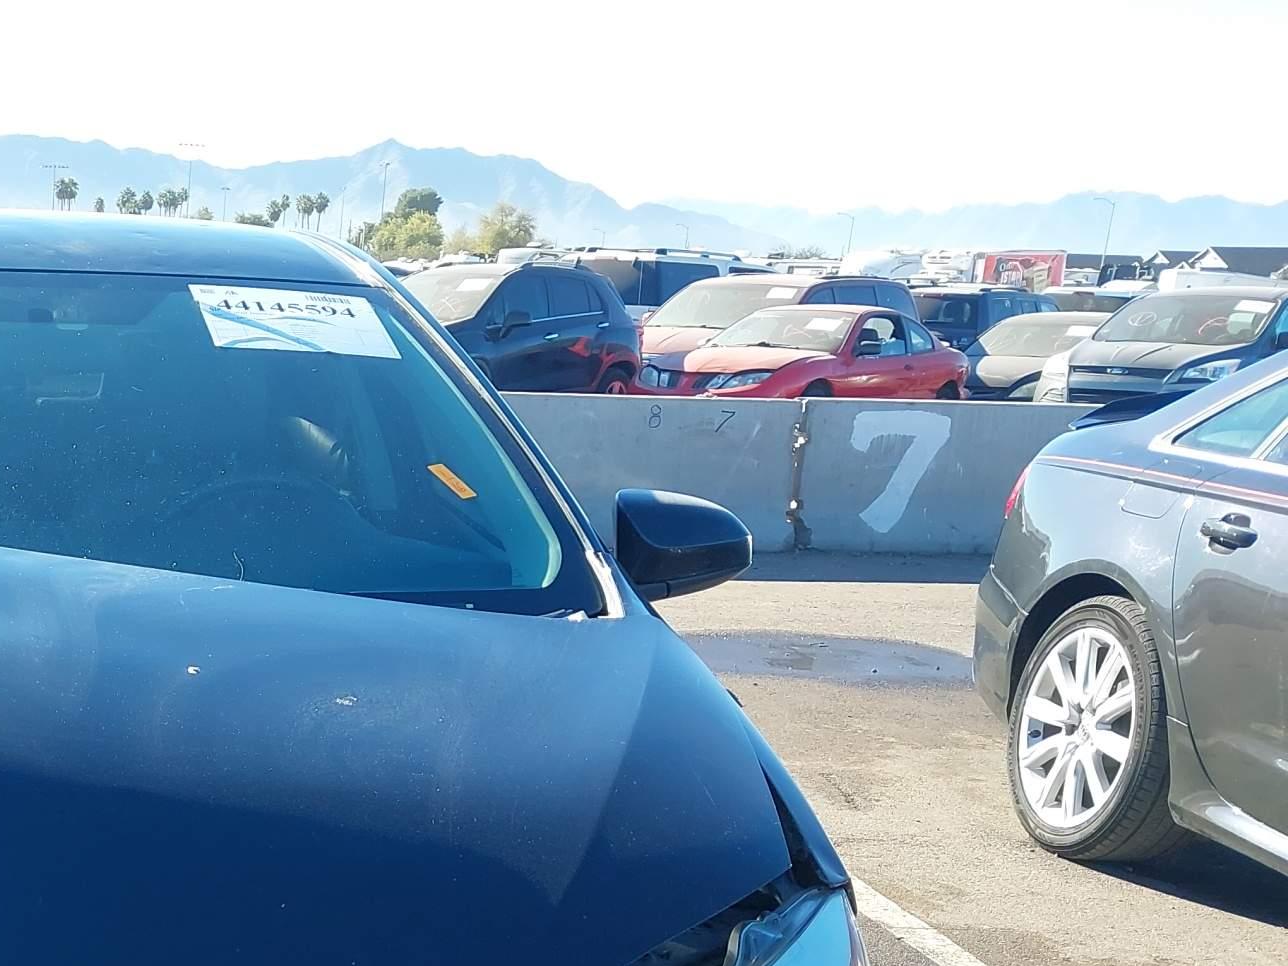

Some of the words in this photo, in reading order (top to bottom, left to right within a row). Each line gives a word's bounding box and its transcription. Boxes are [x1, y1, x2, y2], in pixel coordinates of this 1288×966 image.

[216, 299, 357, 319] 44145594
[647, 404, 662, 429] 8
[714, 409, 736, 433] 7
[850, 409, 952, 534] 7
